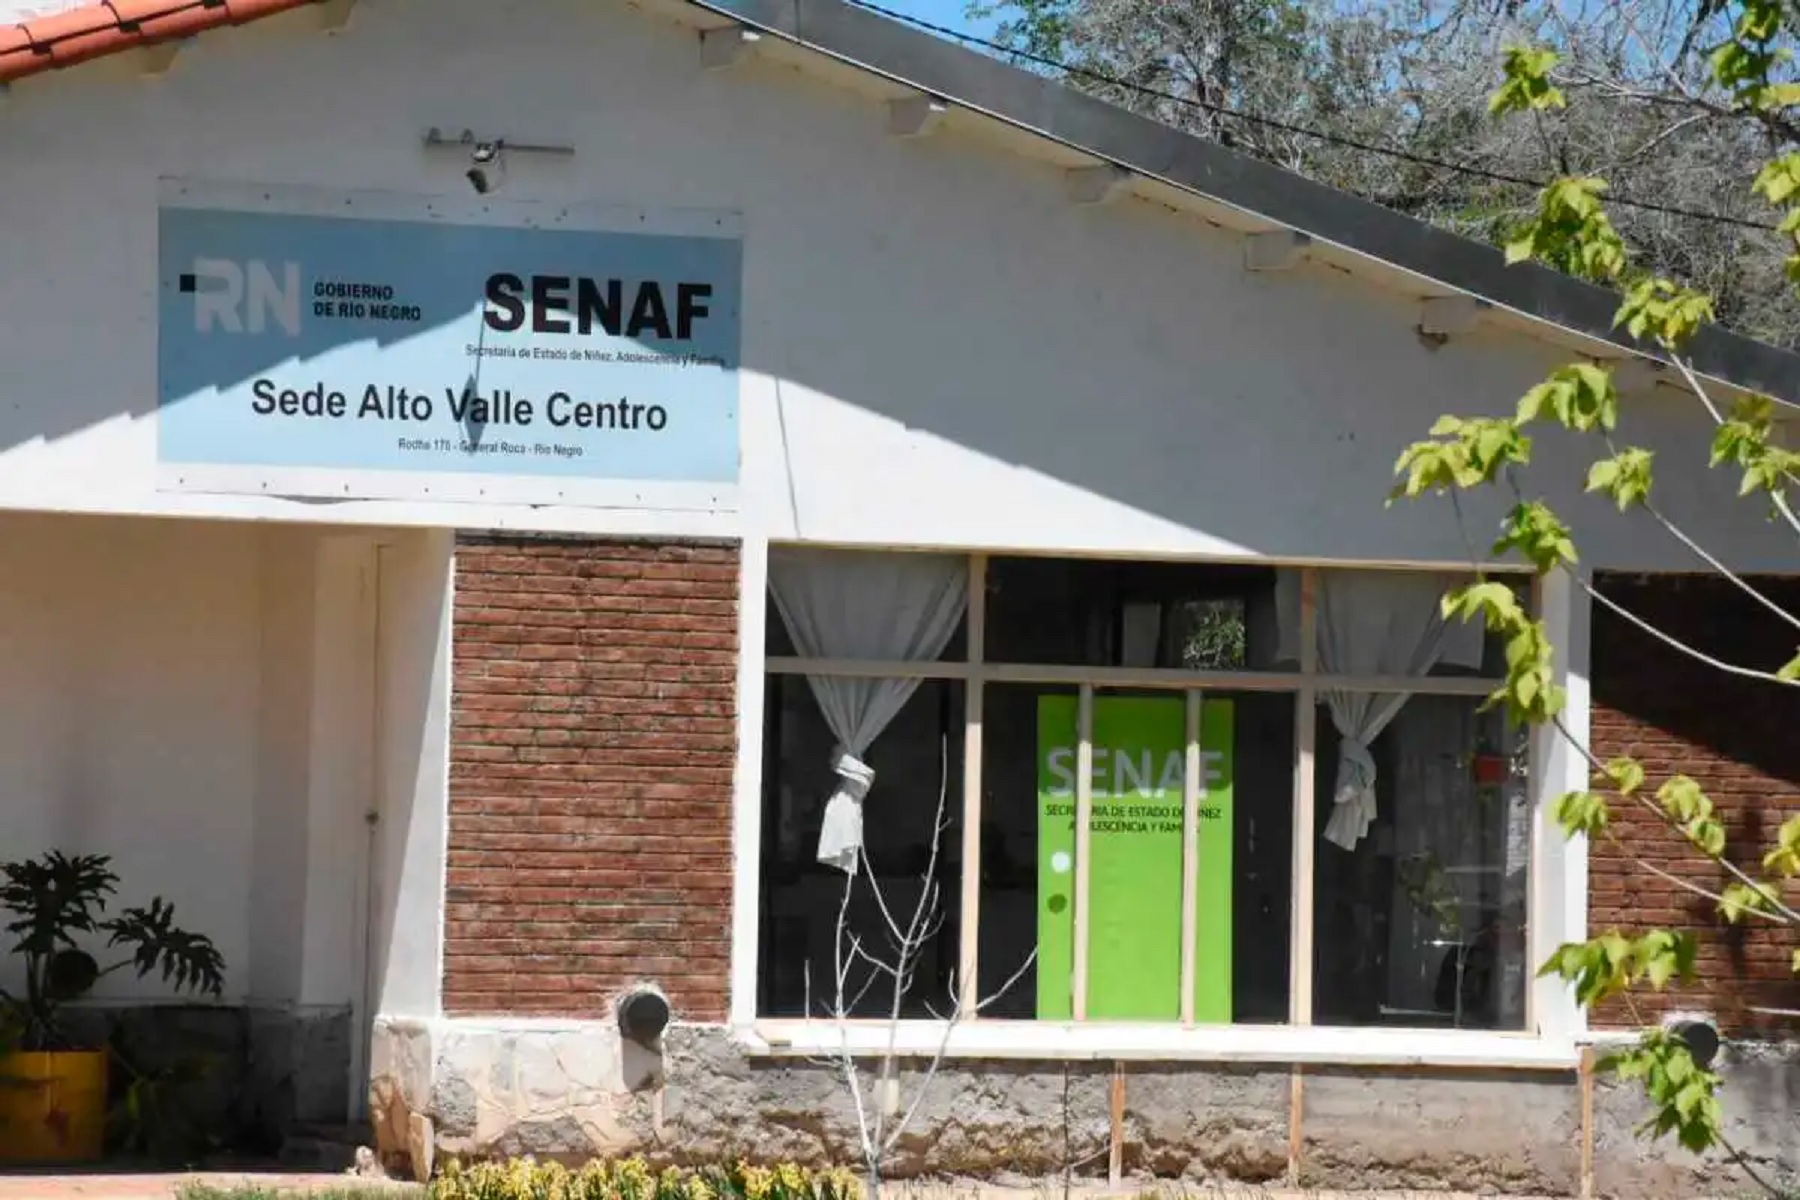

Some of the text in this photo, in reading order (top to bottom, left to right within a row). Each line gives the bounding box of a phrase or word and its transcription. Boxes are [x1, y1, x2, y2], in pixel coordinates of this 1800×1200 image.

[194, 258, 300, 336] RN
[313, 281, 393, 300] GOBIERNO
[313, 301, 335, 316] DE
[369, 304, 421, 321] NEGRO
[484, 272, 713, 340] SENAF
[518, 348, 531, 359] de
[533, 347, 567, 360] Estado
[570, 349, 582, 361] de
[252, 379, 668, 431] Sede Alto Valle Centro
[501, 442, 526, 454] Roca
[553, 444, 583, 458] Negro
[1111, 806, 1124, 817] DE
[1128, 806, 1170, 818] ESTADO
[1150, 822, 1158, 833] Y
